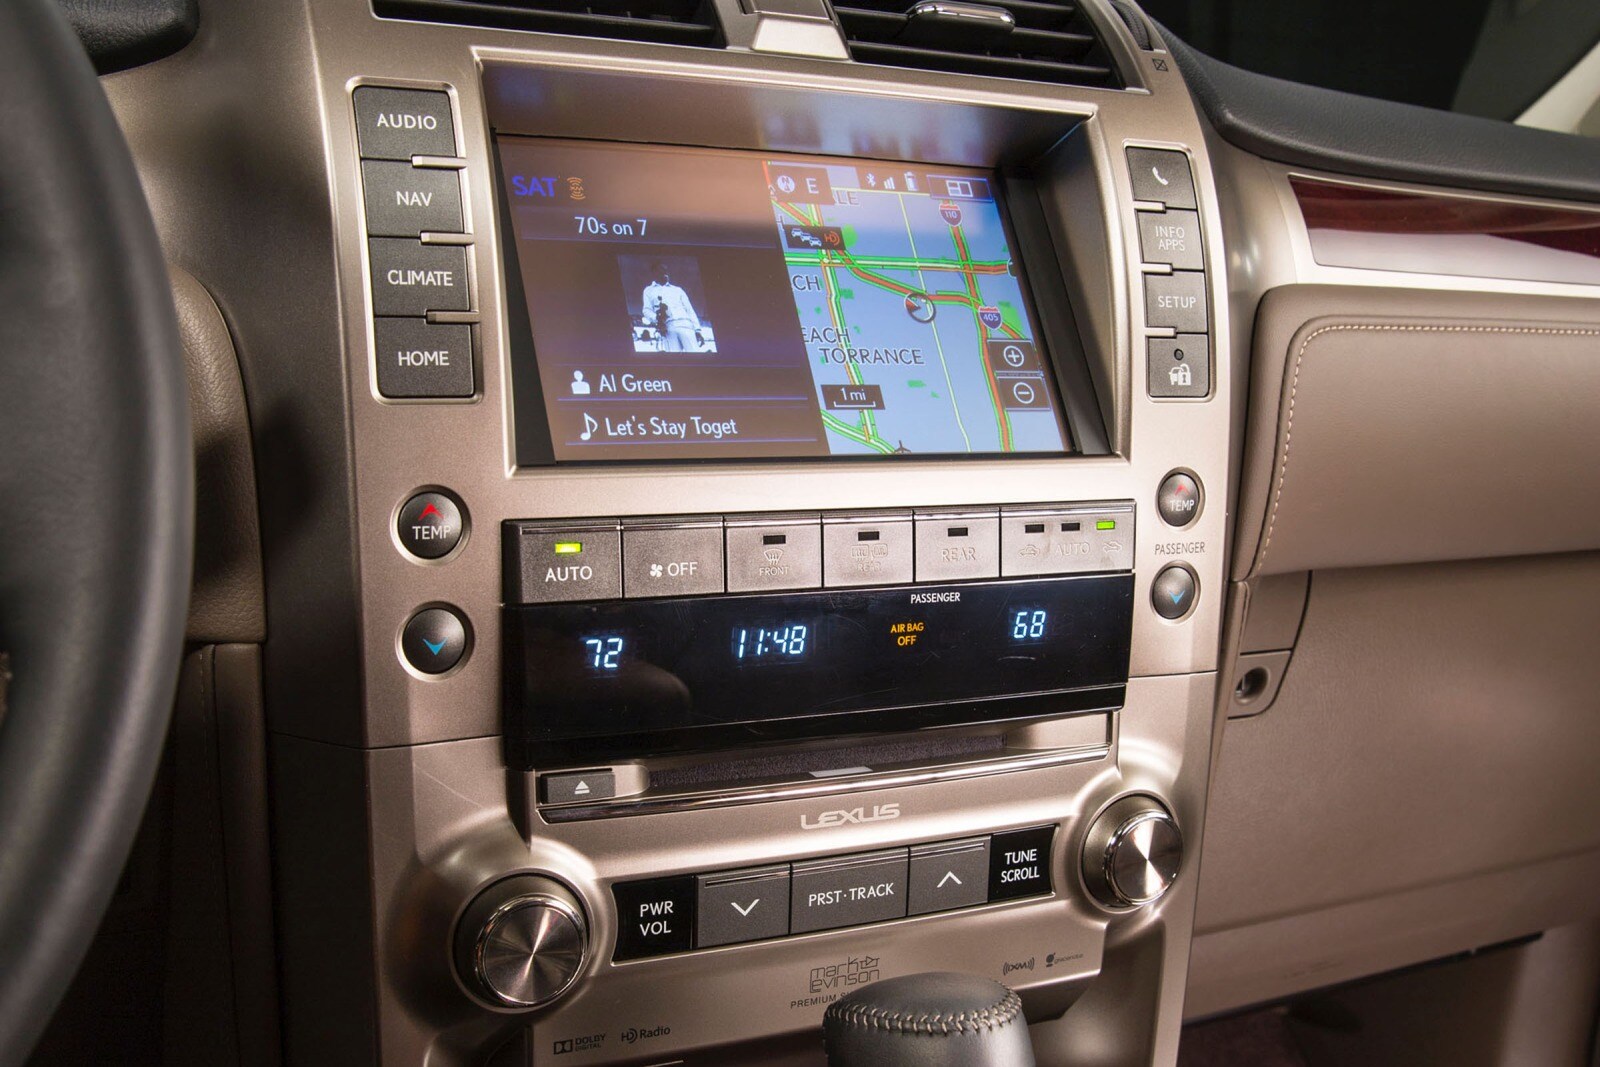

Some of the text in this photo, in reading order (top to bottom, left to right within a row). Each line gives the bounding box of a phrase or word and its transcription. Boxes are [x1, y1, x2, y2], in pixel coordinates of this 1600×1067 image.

[376, 113, 437, 131] AUDIO
[512, 175, 557, 198] SAT
[806, 178, 819, 194] E
[395, 190, 432, 208] NAV
[574, 216, 647, 236] 70s on 7
[1155, 226, 1185, 239] INFO
[1158, 238, 1186, 252] APPS
[387, 269, 453, 287] CLIMATE
[792, 274, 821, 291] CH
[1157, 295, 1196, 308] SETUP
[983, 314, 999, 322] 405
[397, 350, 450, 367] HOME
[819, 347, 925, 366] TORRANCE
[621, 373, 673, 393] Green
[840, 387, 866, 401] 1 mi
[605, 415, 738, 439] Let's Stay Toget
[1169, 499, 1195, 512] TEMP
[412, 524, 452, 541] TEMP
[941, 547, 976, 563] REAR
[1054, 541, 1091, 557] AUTO
[1154, 540, 1206, 556] PASSENGER
[544, 565, 593, 583] AUTO
[667, 561, 698, 577] OFF
[759, 566, 790, 577] FRONT
[910, 592, 961, 604] PASSENGER
[890, 622, 924, 634] AIR BAG
[1013, 610, 1046, 639] 68
[738, 625, 806, 659] 11:48
[897, 635, 917, 647] OFF
[586, 638, 623, 668] 72
[800, 803, 900, 830] LEXUS
[1005, 849, 1037, 865] TUNE
[1000, 866, 1040, 883] SCROLL
[640, 901, 674, 918] PWR
[639, 920, 672, 937] VOL
[790, 994, 837, 1009] PREMIUM
[575, 1033, 606, 1045] DOLBY
[639, 1026, 671, 1039] Radio
